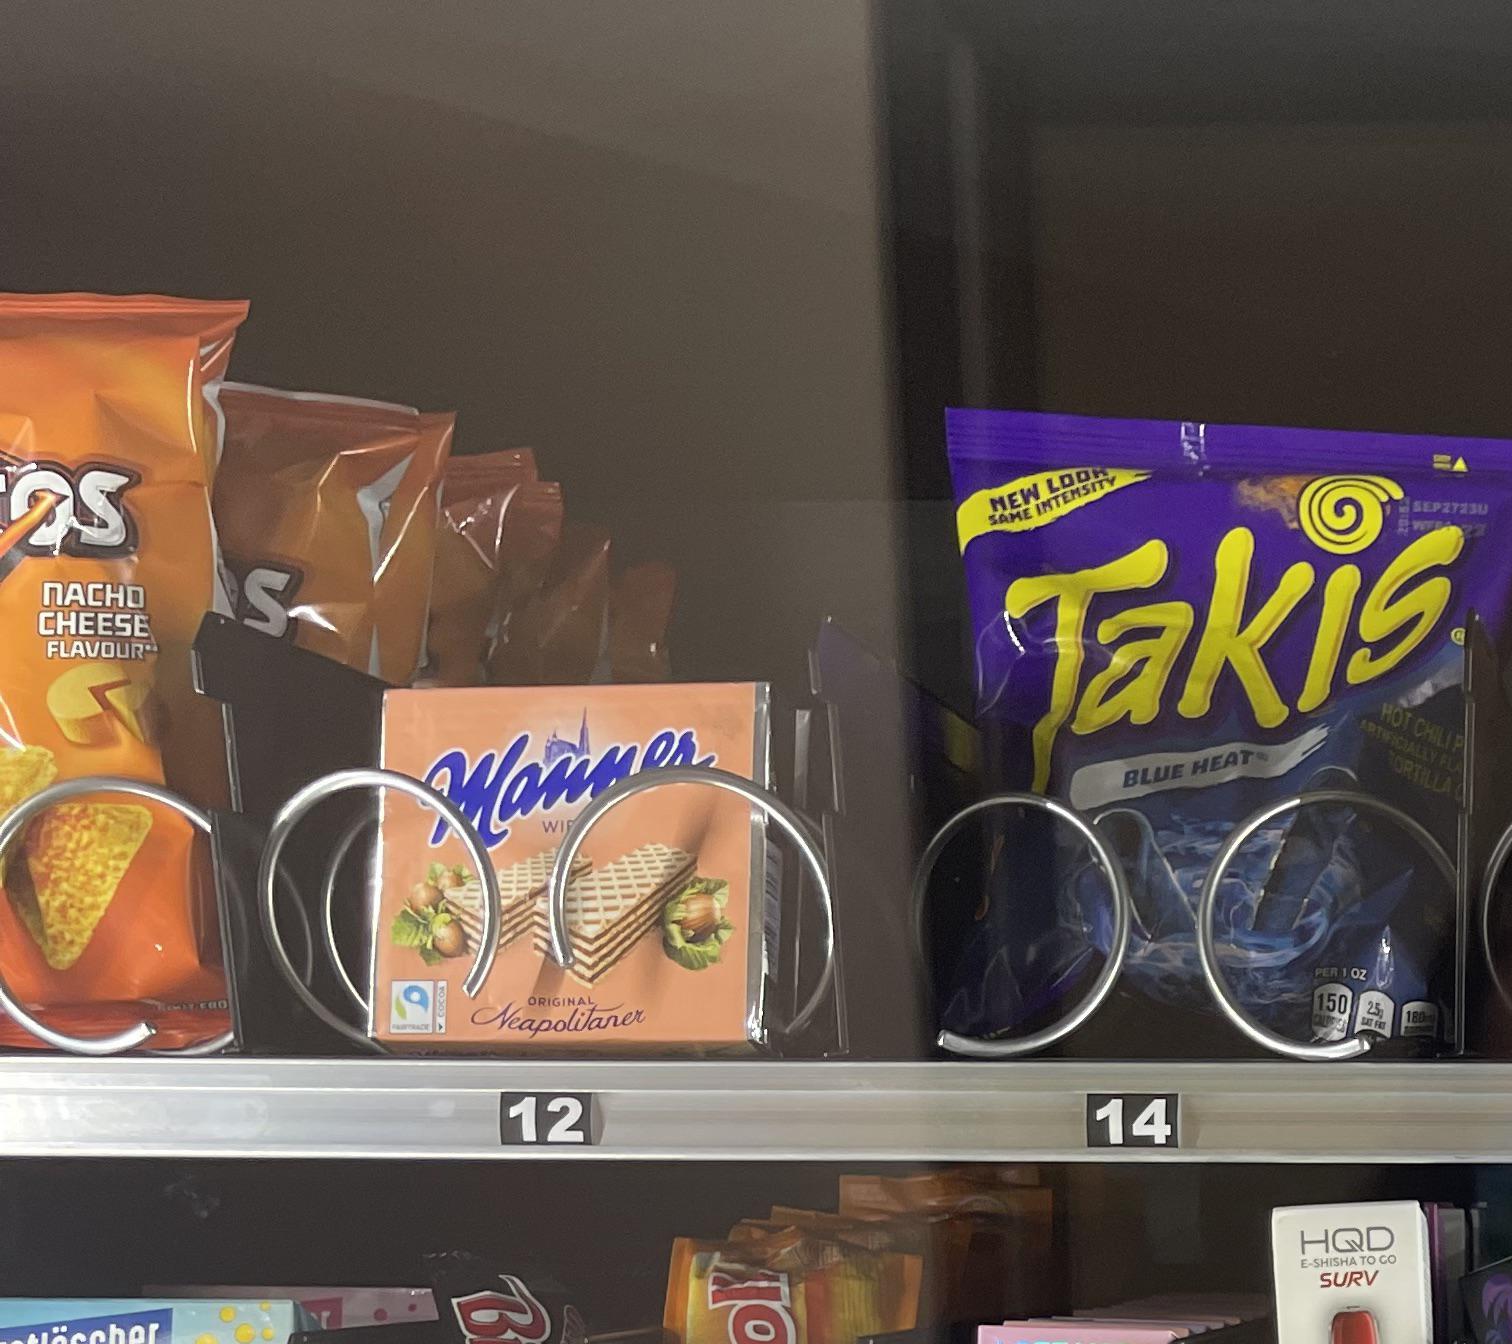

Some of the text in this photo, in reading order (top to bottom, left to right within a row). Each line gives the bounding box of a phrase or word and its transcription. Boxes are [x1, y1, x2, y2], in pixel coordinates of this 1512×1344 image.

[988, 476, 1117, 526] SAME INTENSITY
[989, 483, 1040, 512] NEW
[42, 582, 145, 609] NACHO
[38, 611, 150, 638] CHEESE
[1005, 526, 1465, 793] Takis
[1122, 749, 1254, 789] BLUE HEAT
[422, 730, 716, 848] Manner
[1351, 968, 1368, 980] OZ
[527, 996, 596, 1007] ORIGINAL
[1317, 994, 1348, 1014] 150
[471, 1003, 647, 1039] Neapolitaner
[509, 1096, 584, 1143] 12
[1095, 1098, 1172, 1145] 14
[1301, 1226, 1395, 1255] HQD
[1301, 1255, 1397, 1269] E-SHISHA TO GO
[1320, 1271, 1379, 1288] SURV
